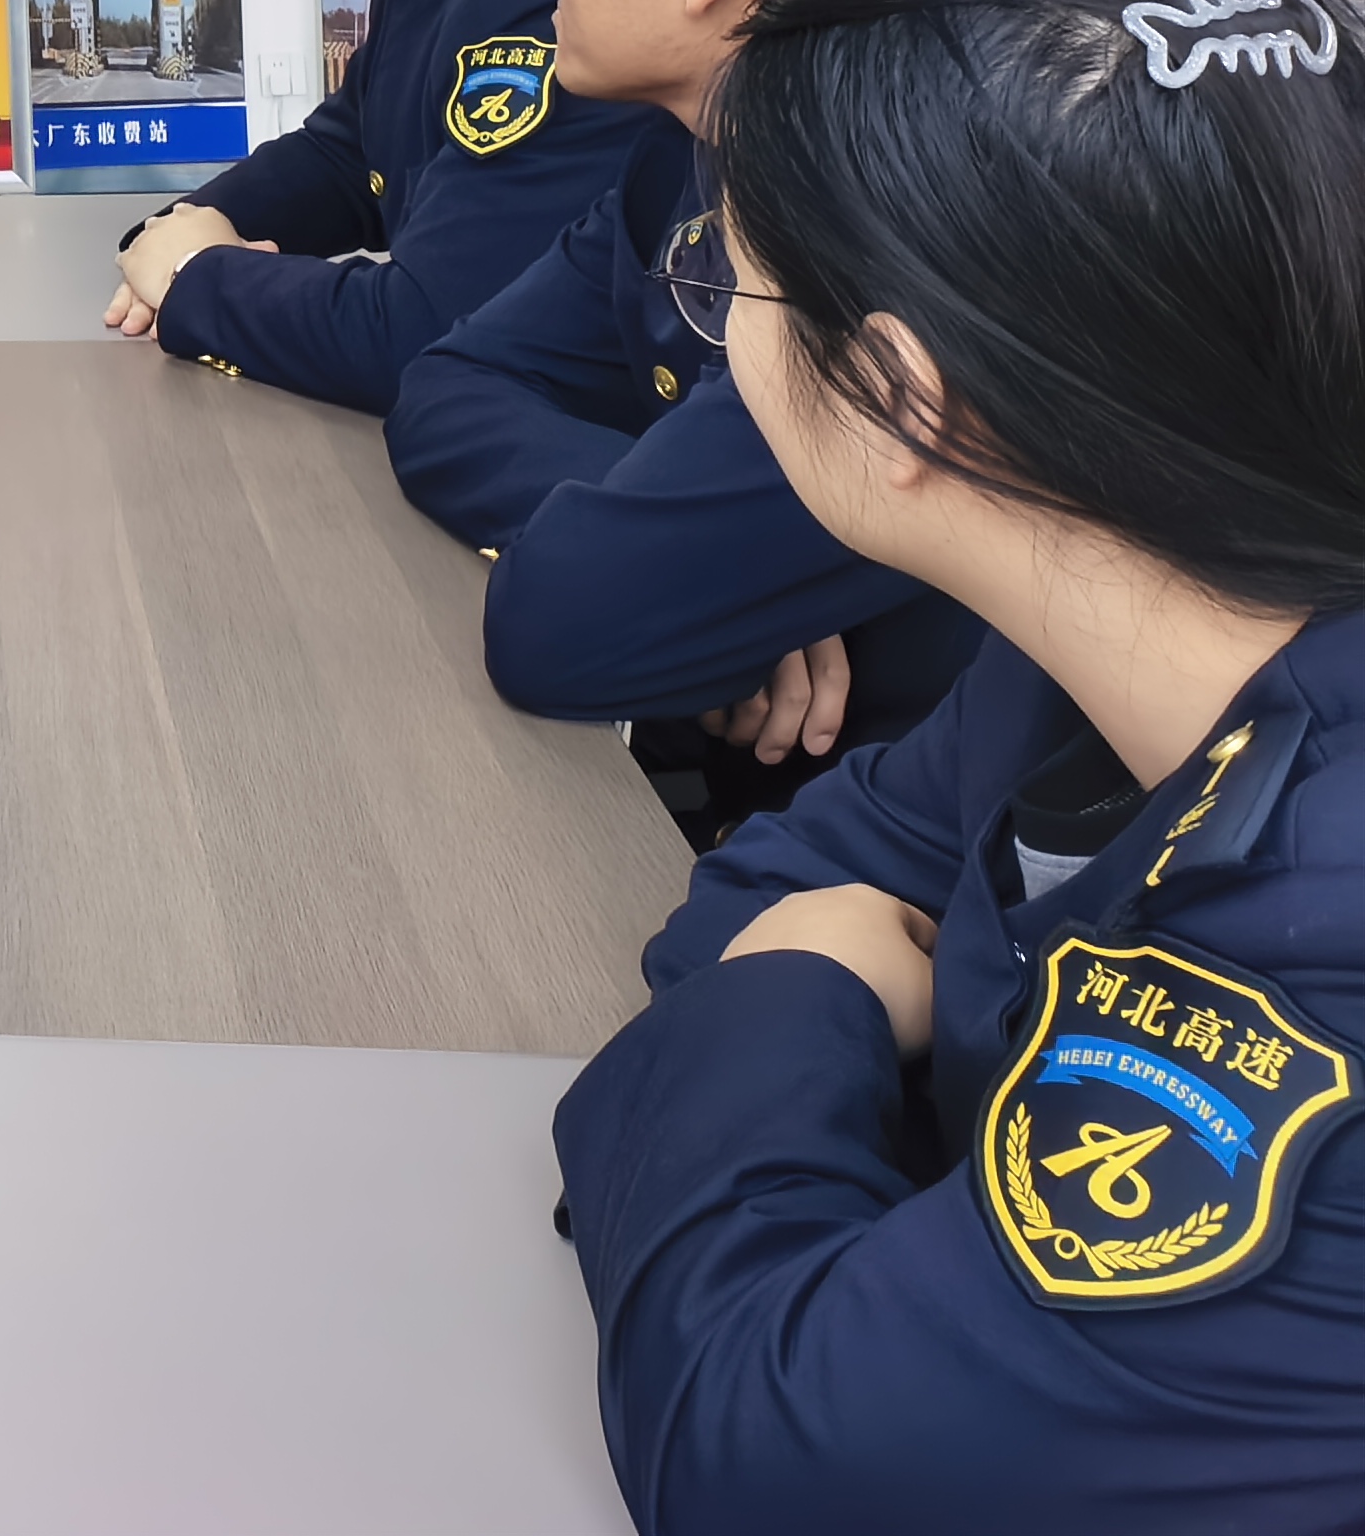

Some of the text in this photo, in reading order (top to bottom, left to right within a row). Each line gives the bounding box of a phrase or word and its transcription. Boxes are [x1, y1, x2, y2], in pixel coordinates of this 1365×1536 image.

[471, 48, 546, 66] 河北高速
[1075, 960, 1295, 1091] 河北高速
[1058, 1048, 1239, 1146] HEBEI EXPRESSWAY
